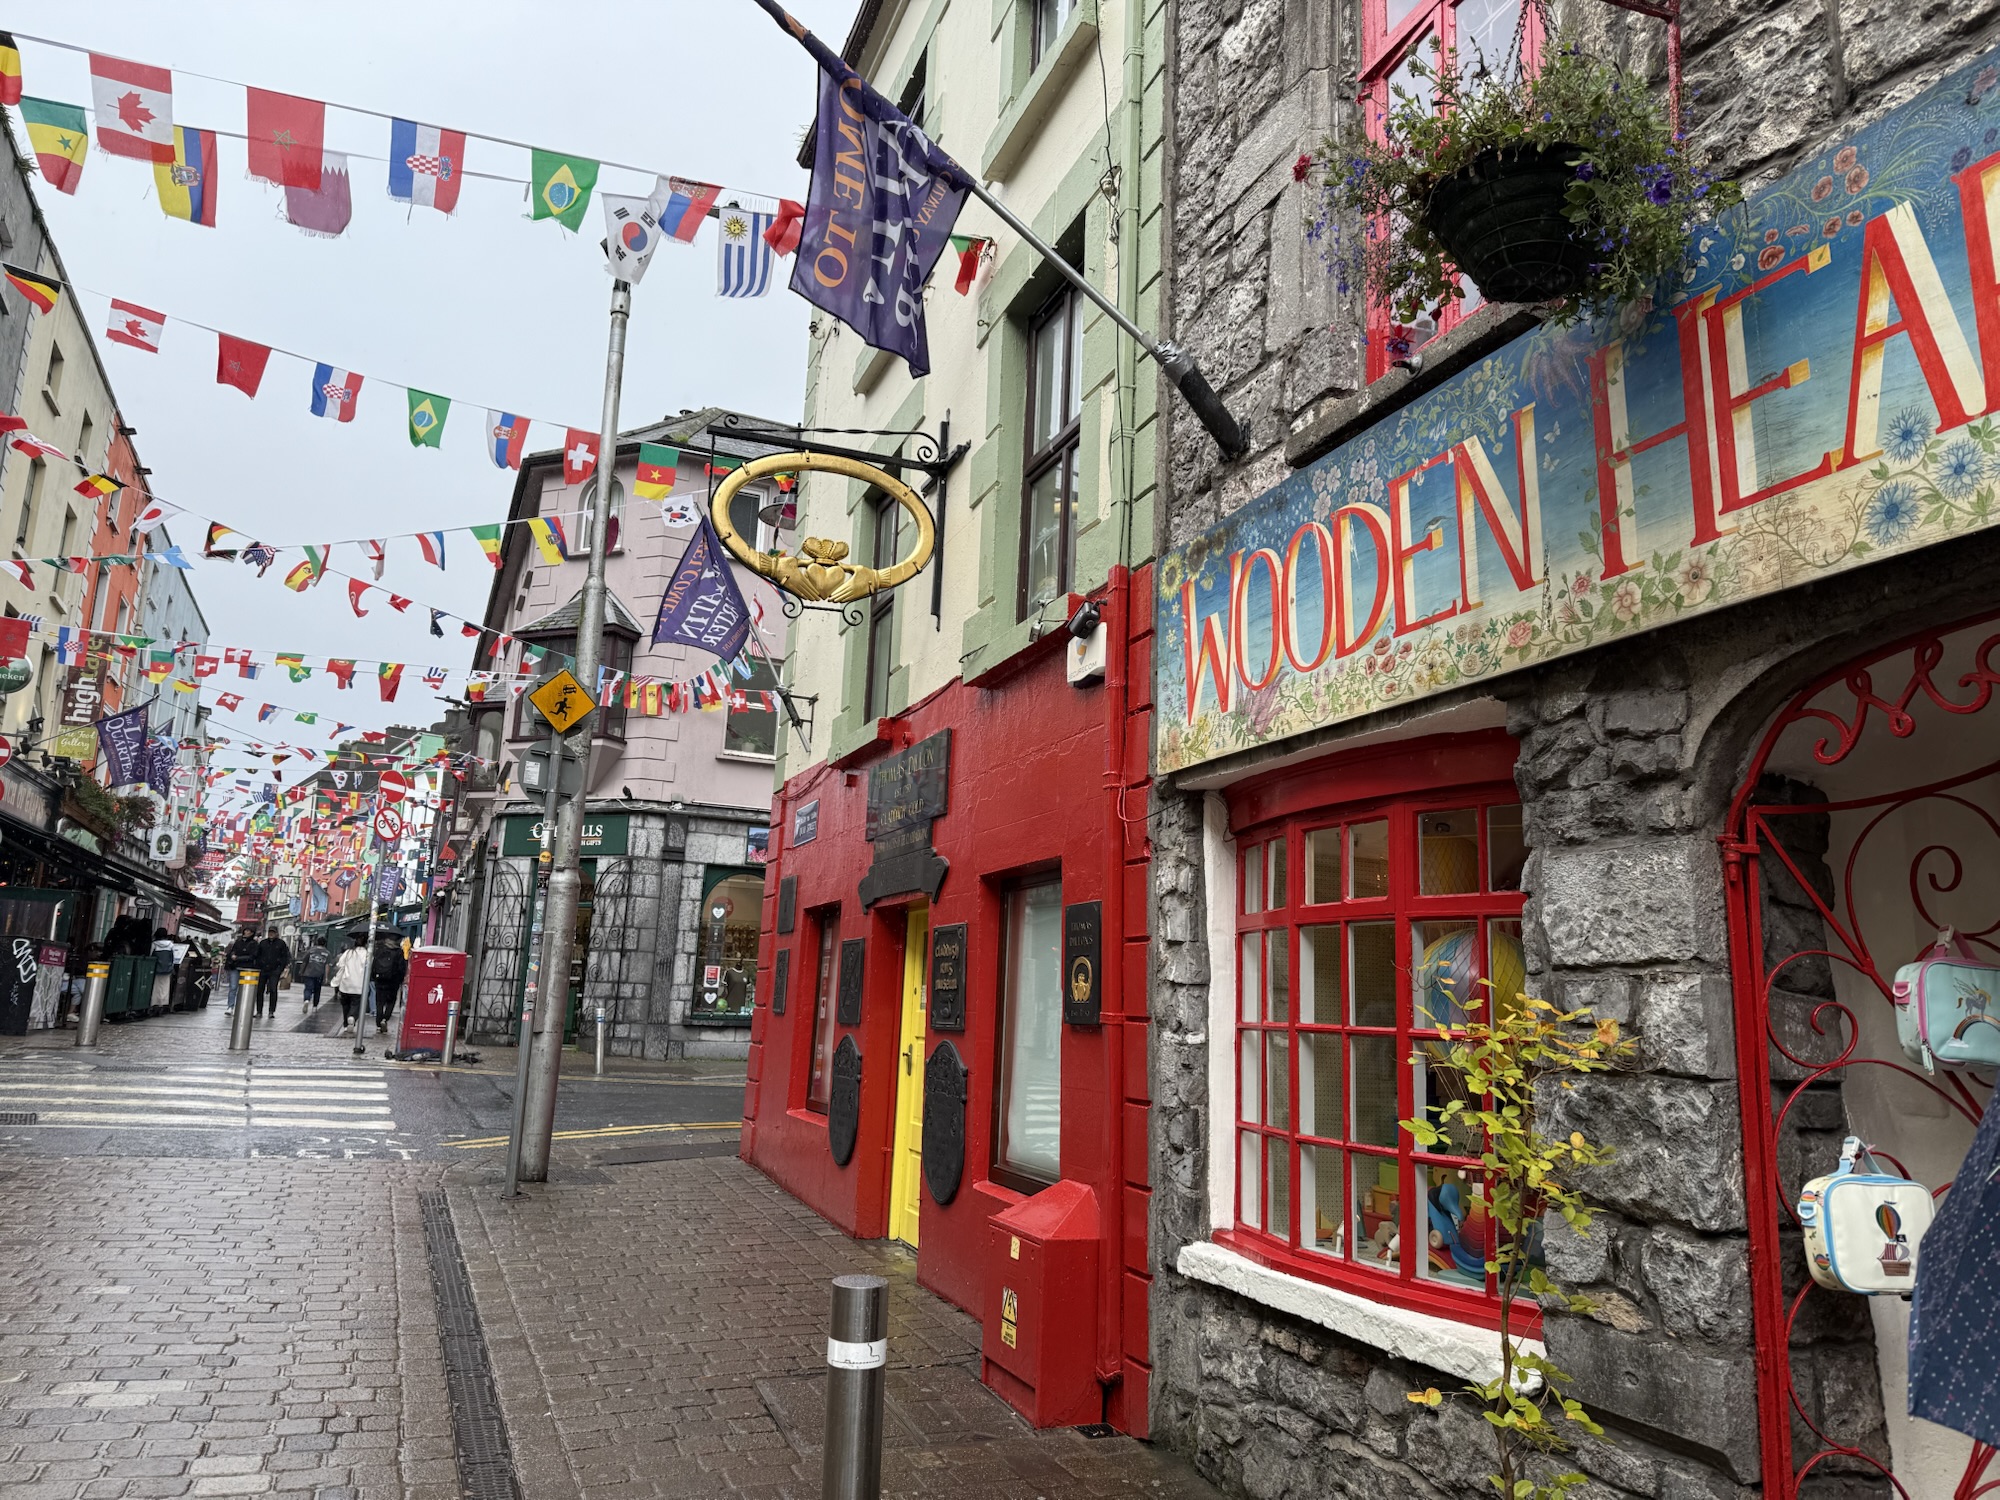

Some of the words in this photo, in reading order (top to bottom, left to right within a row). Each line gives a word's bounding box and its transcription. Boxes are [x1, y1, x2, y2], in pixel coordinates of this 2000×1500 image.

[1181, 401, 1547, 727] WOODEN
[0, 672, 25, 681] eken
[61, 737, 91, 750] Gallery
[877, 760, 906, 789] THOMAS
[907, 747, 935, 776] DILLON
[1070, 920, 1093, 932] THOMAS
